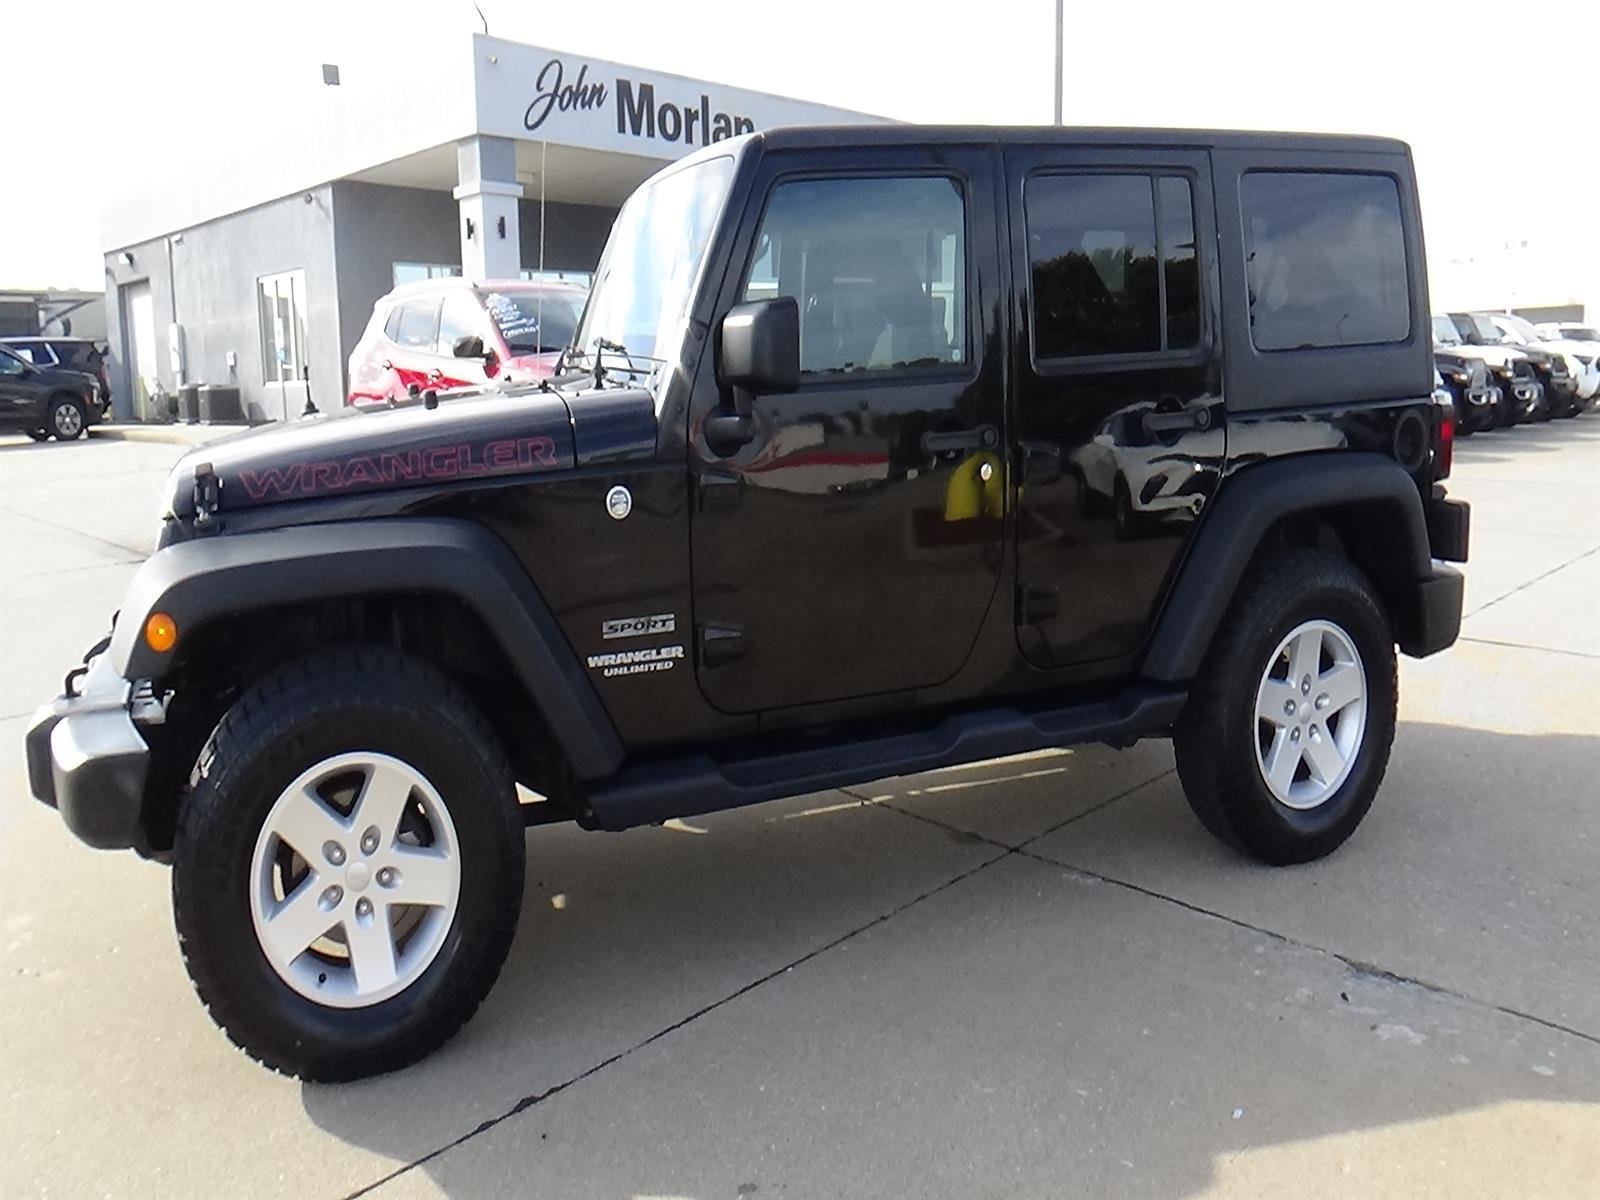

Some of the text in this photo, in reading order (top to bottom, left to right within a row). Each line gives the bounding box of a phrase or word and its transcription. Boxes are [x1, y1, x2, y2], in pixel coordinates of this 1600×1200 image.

[524, 59, 608, 131] John
[238, 436, 558, 500] WRANGLER
[606, 617, 674, 635] SPORT
[588, 646, 684, 668] WRANGLER
[604, 661, 674, 677] UNLIMITED
